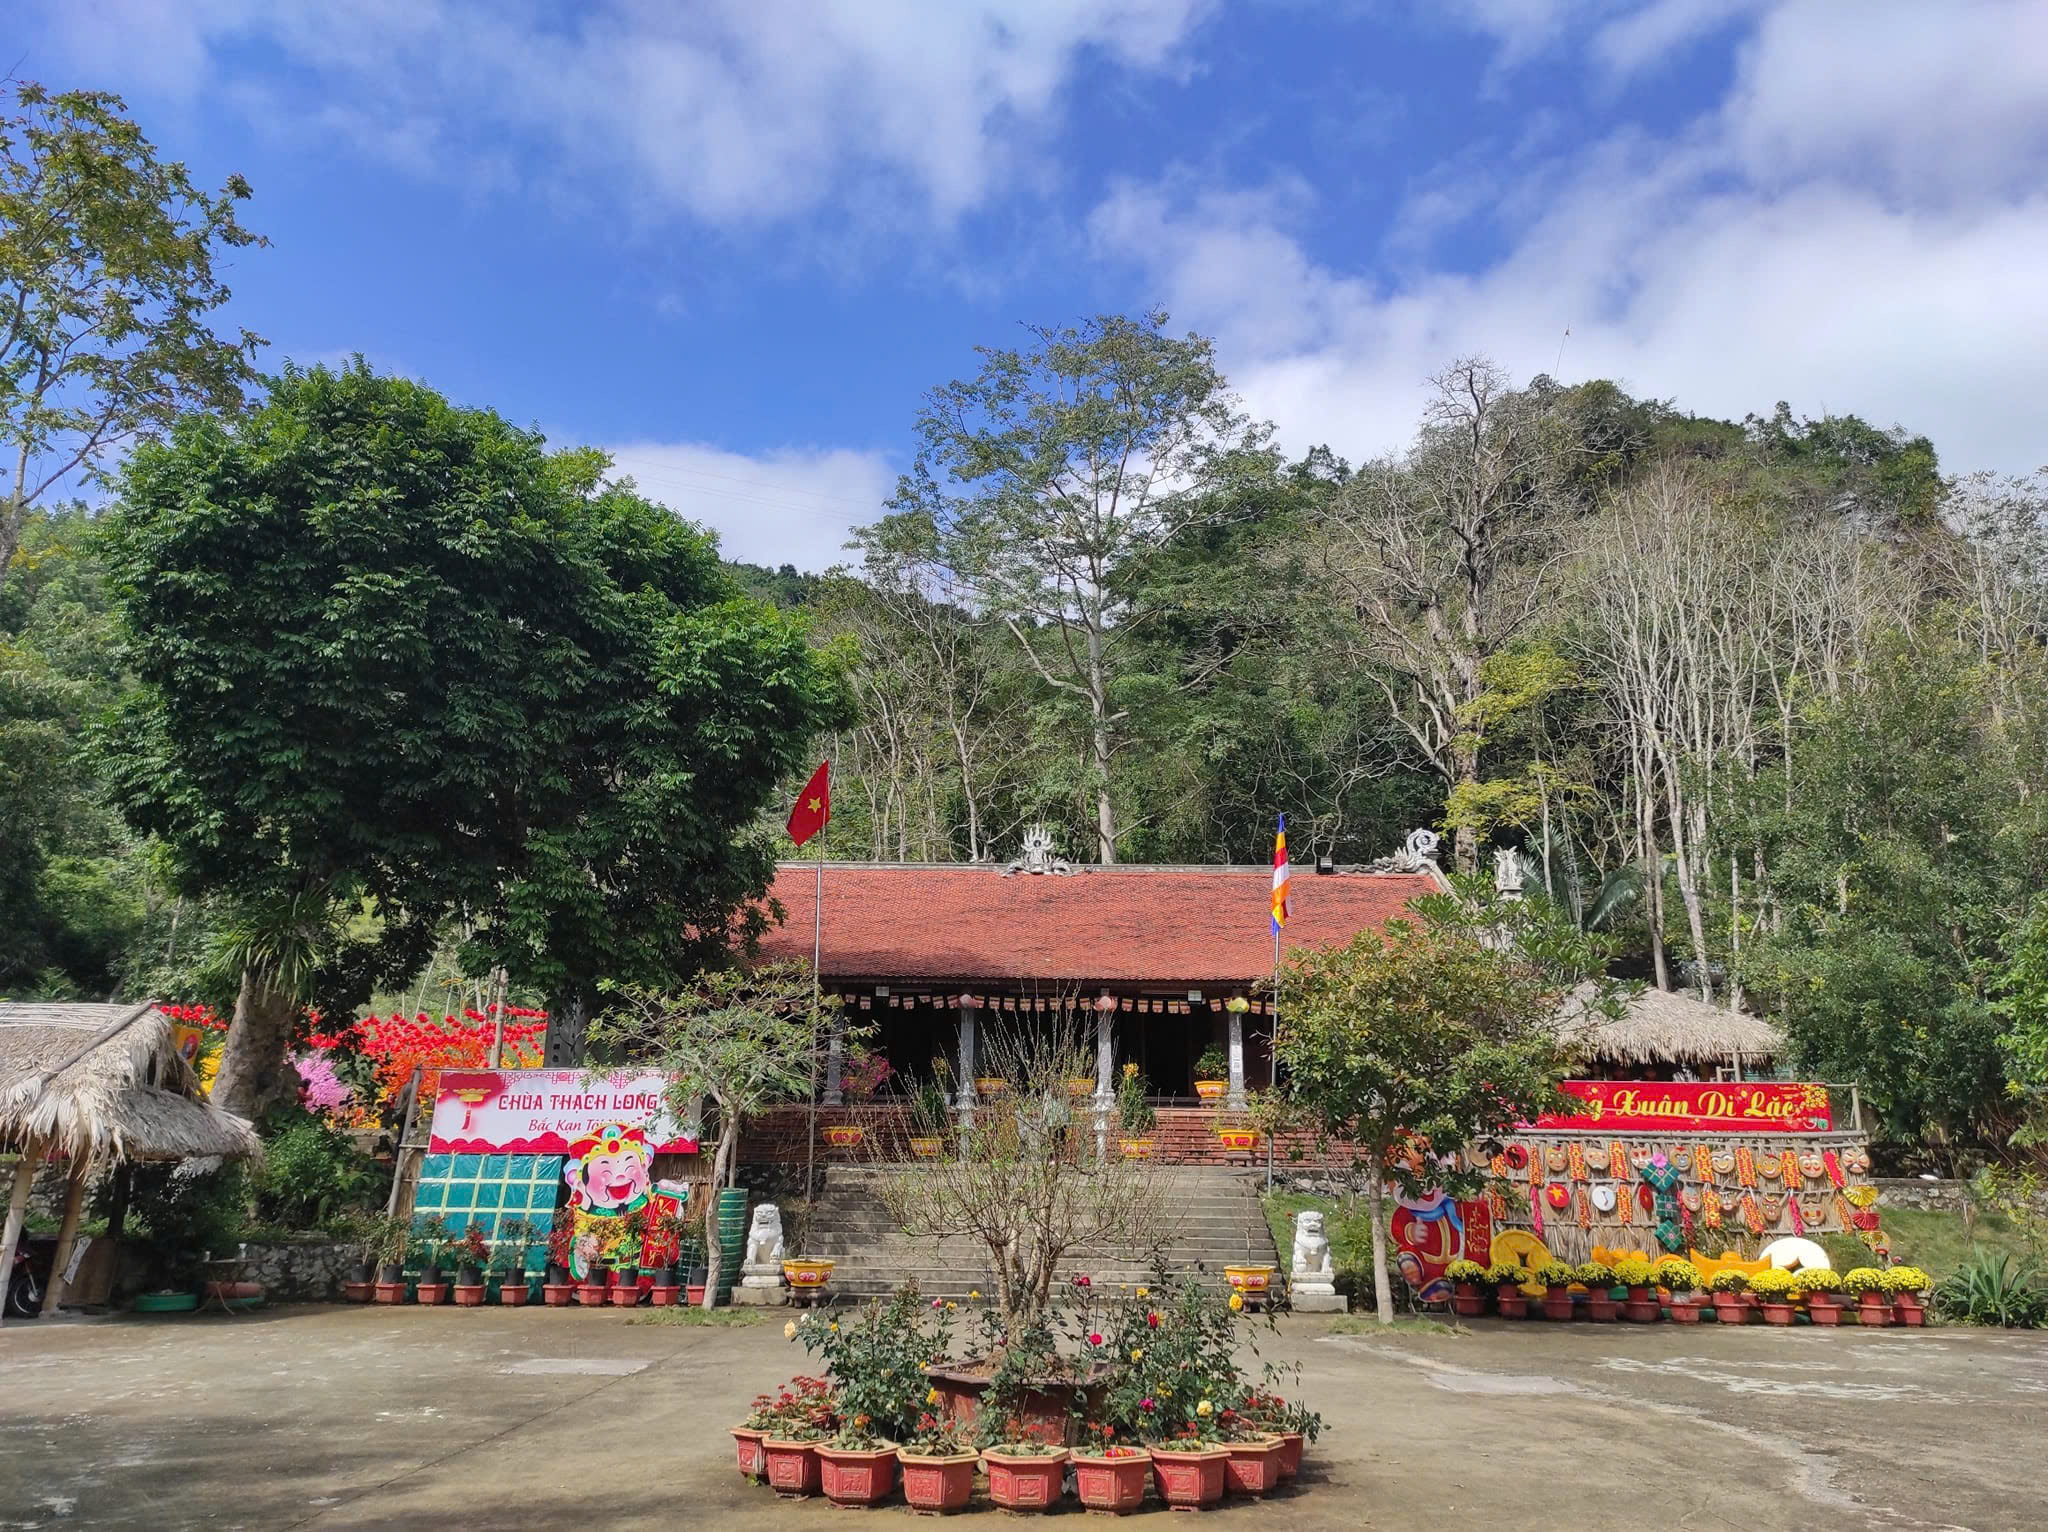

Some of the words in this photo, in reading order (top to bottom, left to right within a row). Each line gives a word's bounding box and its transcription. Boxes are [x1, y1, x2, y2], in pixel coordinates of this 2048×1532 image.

[498, 1091, 543, 1110] CHÙA
[551, 1094, 607, 1113] THẠCH
[613, 1094, 658, 1110] LONG
[1613, 1089, 1688, 1116] Xuân
[1698, 1090, 1737, 1117] Di
[1743, 1090, 1796, 1122] Lặc
[528, 1117, 550, 1131] Bắc
[555, 1119, 581, 1134] Kạn
